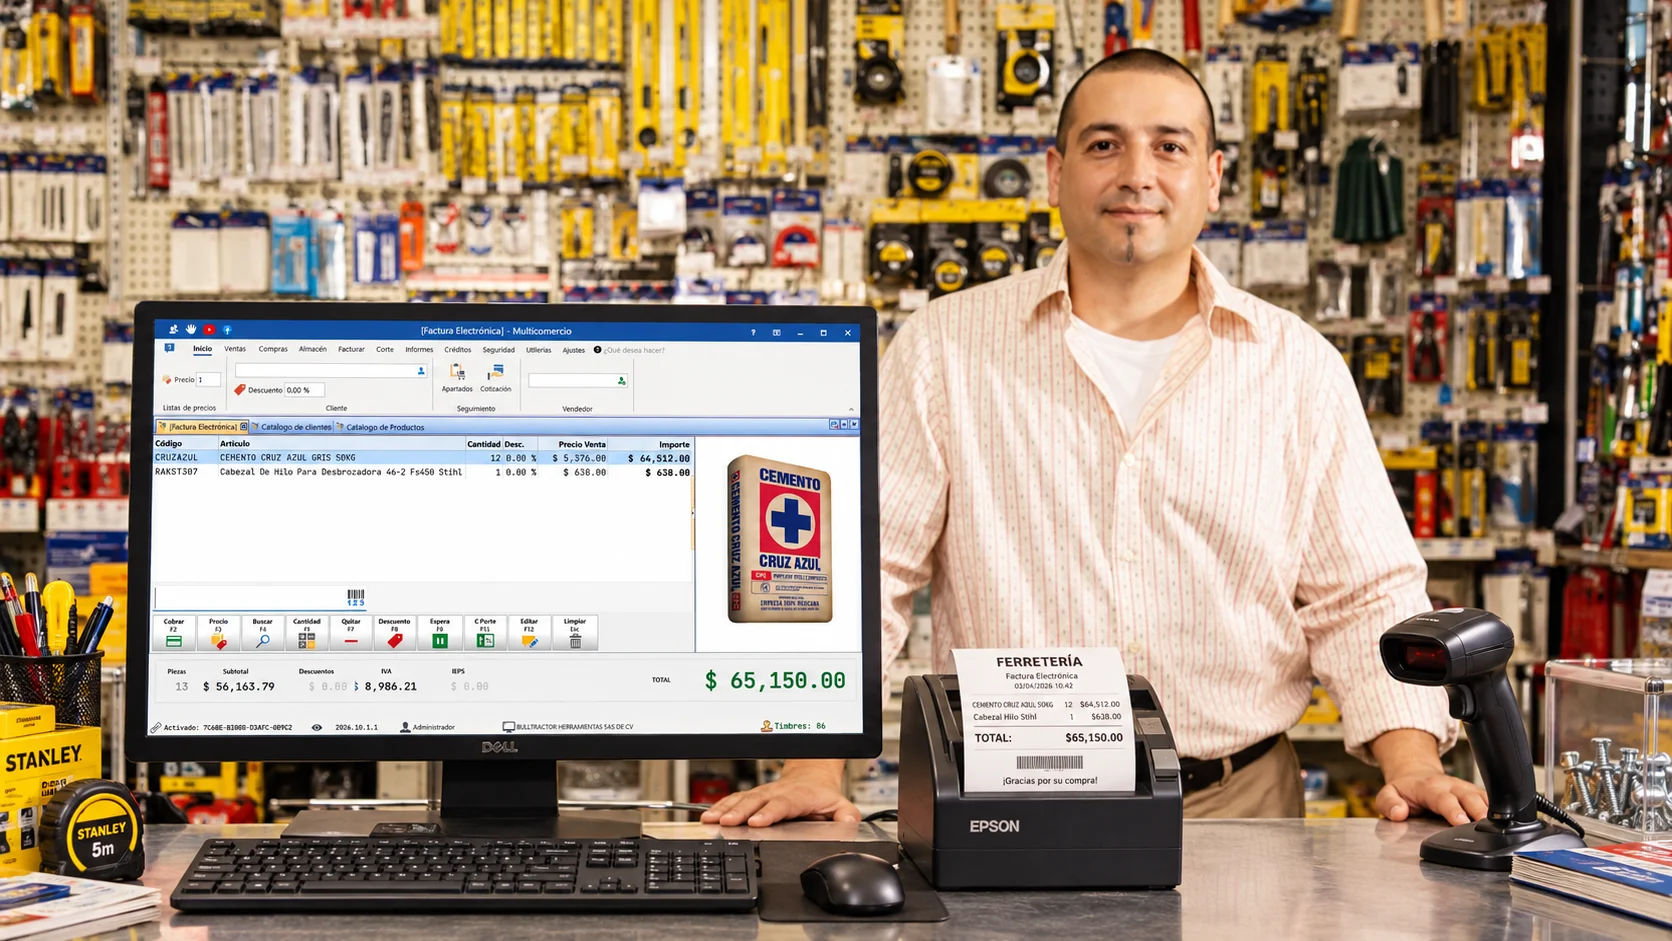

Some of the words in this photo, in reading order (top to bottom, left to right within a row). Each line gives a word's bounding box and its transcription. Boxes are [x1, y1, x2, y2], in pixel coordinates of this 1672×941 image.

[421, 326, 454, 336] [Factura
[456, 326, 504, 336] Electrónica]
[512, 327, 572, 336] Multicomercio
[258, 346, 288, 354] Compras
[603, 346, 621, 354] ¿Qué
[199, 422, 237, 431] Electrónica]
[553, 454, 558, 463] $
[628, 454, 633, 463] $
[564, 468, 569, 477] $
[645, 468, 651, 477] $
[760, 468, 820, 491] CEMENTO
[731, 482, 740, 534] CEMENTO
[731, 535, 740, 563] CRUZ
[760, 554, 791, 569] CRUZ
[794, 557, 821, 571] AZUL
[996, 655, 1083, 667] FERRETERÍA
[176, 682, 188, 691] 13
[309, 681, 315, 691] $
[321, 682, 347, 691] 0.00
[451, 681, 457, 691] $
[464, 682, 489, 691] 0.00
[705, 670, 717, 692] $
[730, 671, 846, 692] 65,150.00
[203, 681, 209, 692] $
[216, 682, 275, 693] 56,163.79
[365, 682, 417, 692] 8,986.21
[975, 733, 1012, 743] TOTAL:
[1066, 732, 1124, 744] $65,150.00
[481, 741, 518, 753] DELL
[6, 744, 81, 772] STANLEY
[1003, 777, 1035, 786] ¡Gracias
[1065, 777, 1098, 785] compra!
[77, 822, 126, 840] STANLEY
[970, 820, 1020, 832] EPSON
[92, 842, 114, 857] 5m
